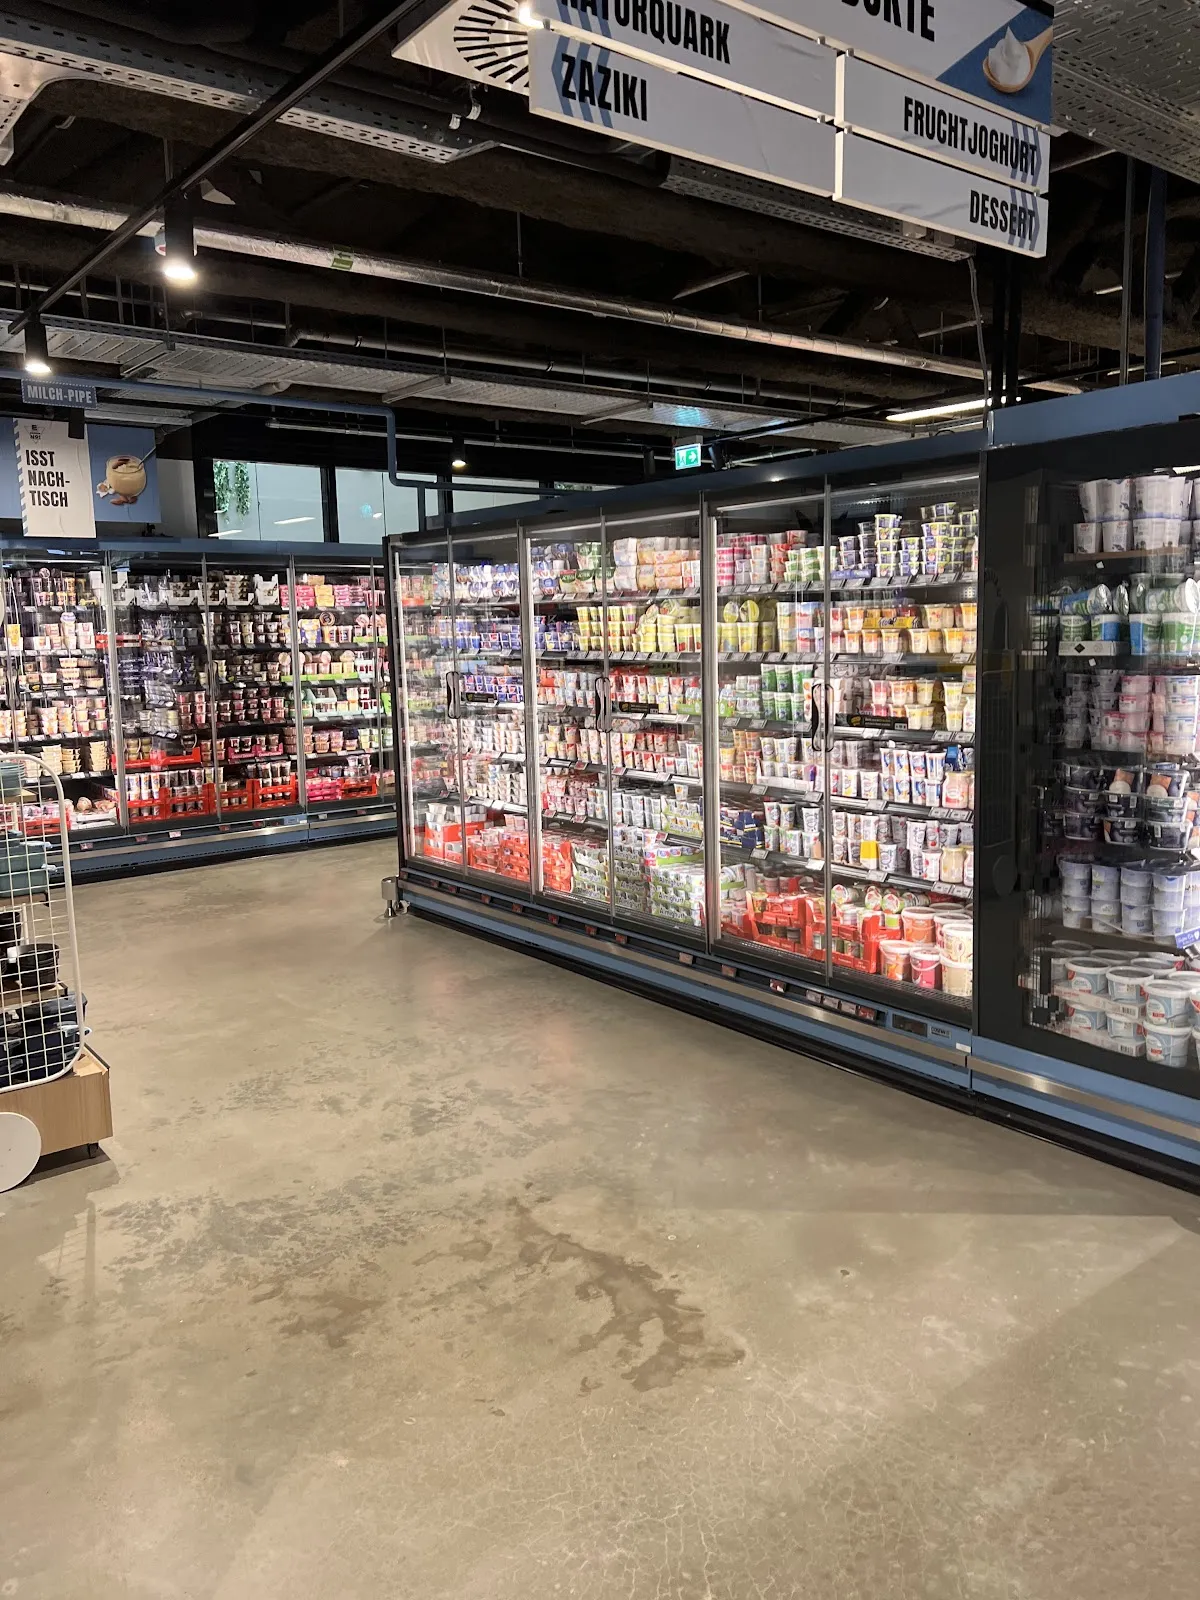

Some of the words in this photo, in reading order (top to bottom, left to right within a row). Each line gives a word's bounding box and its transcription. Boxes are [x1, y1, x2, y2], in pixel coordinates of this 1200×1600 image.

[561, 53, 647, 122] ZAZIKI
[904, 95, 1037, 176] FRUCHTJOGHURT
[969, 189, 1036, 241] DESSERT
[27, 384, 92, 404] MILCH-PIPE
[26, 449, 54, 467] ISST
[27, 469, 70, 488] NACH-
[29, 490, 68, 507] TISCH
